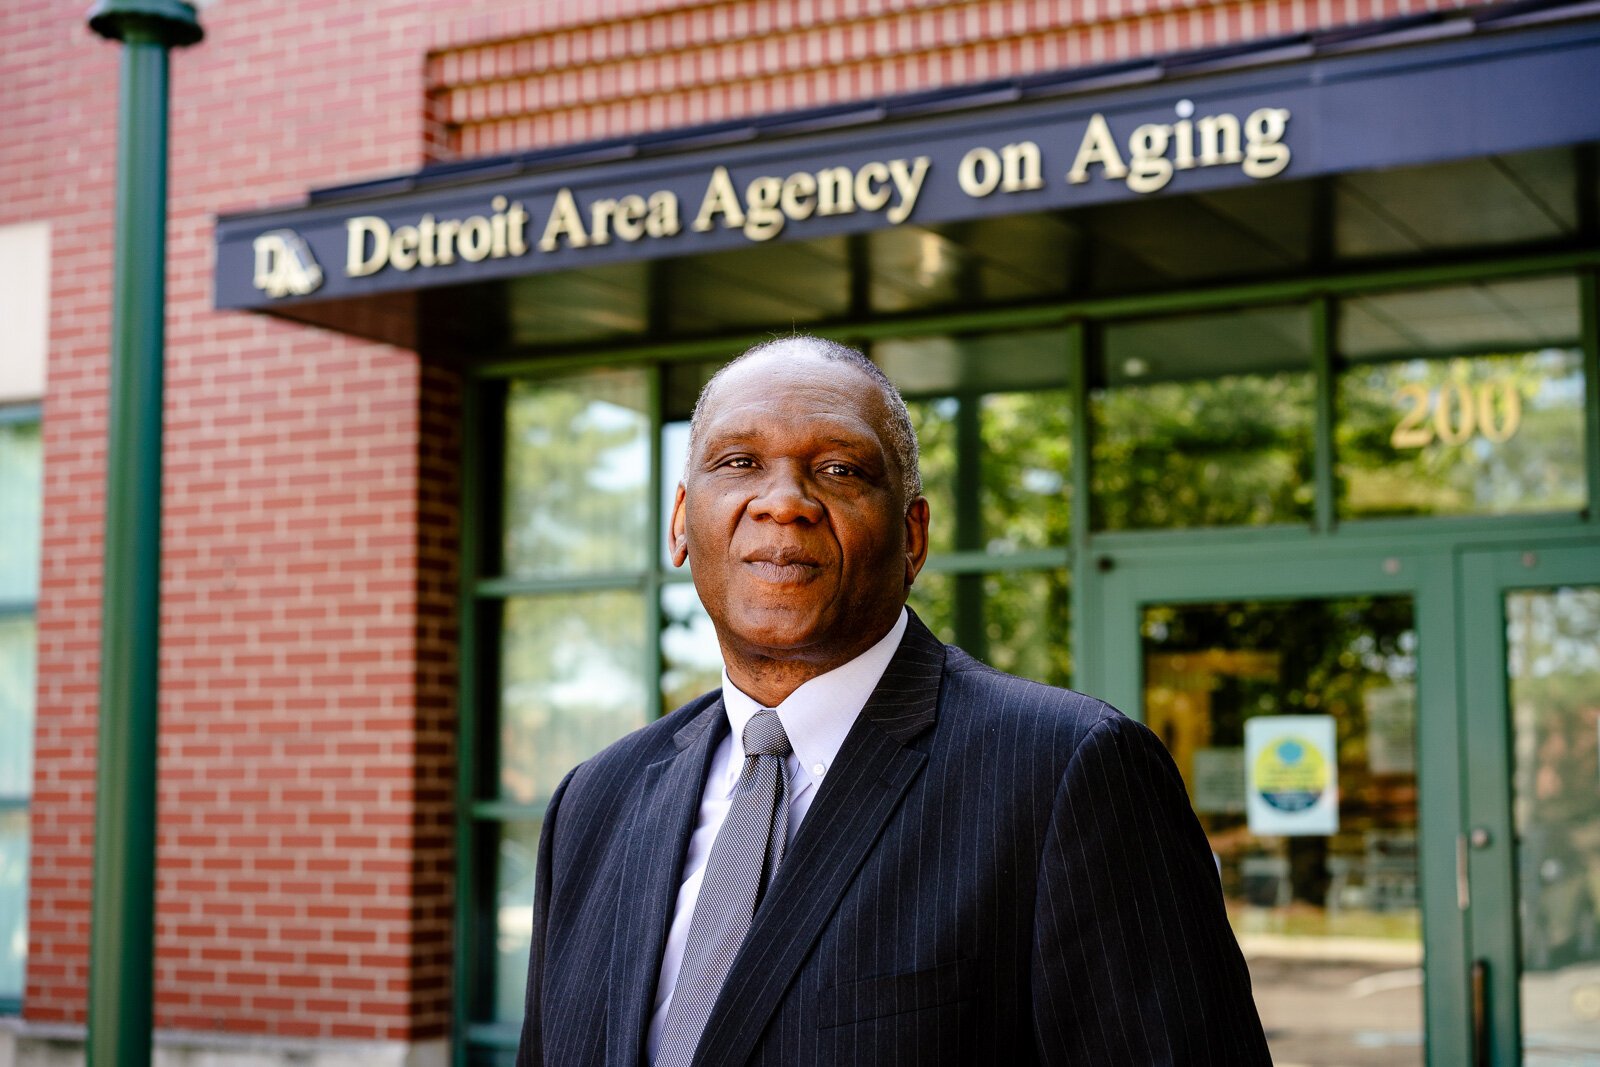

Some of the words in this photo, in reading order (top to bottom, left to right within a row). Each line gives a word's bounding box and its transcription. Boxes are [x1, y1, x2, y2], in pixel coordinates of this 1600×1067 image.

[345, 196, 527, 277] Detroit
[539, 188, 680, 252] Area
[693, 156, 931, 241] Agency
[958, 141, 1044, 197] on
[1067, 99, 1291, 193] Aging
[1390, 381, 1521, 449] 200
